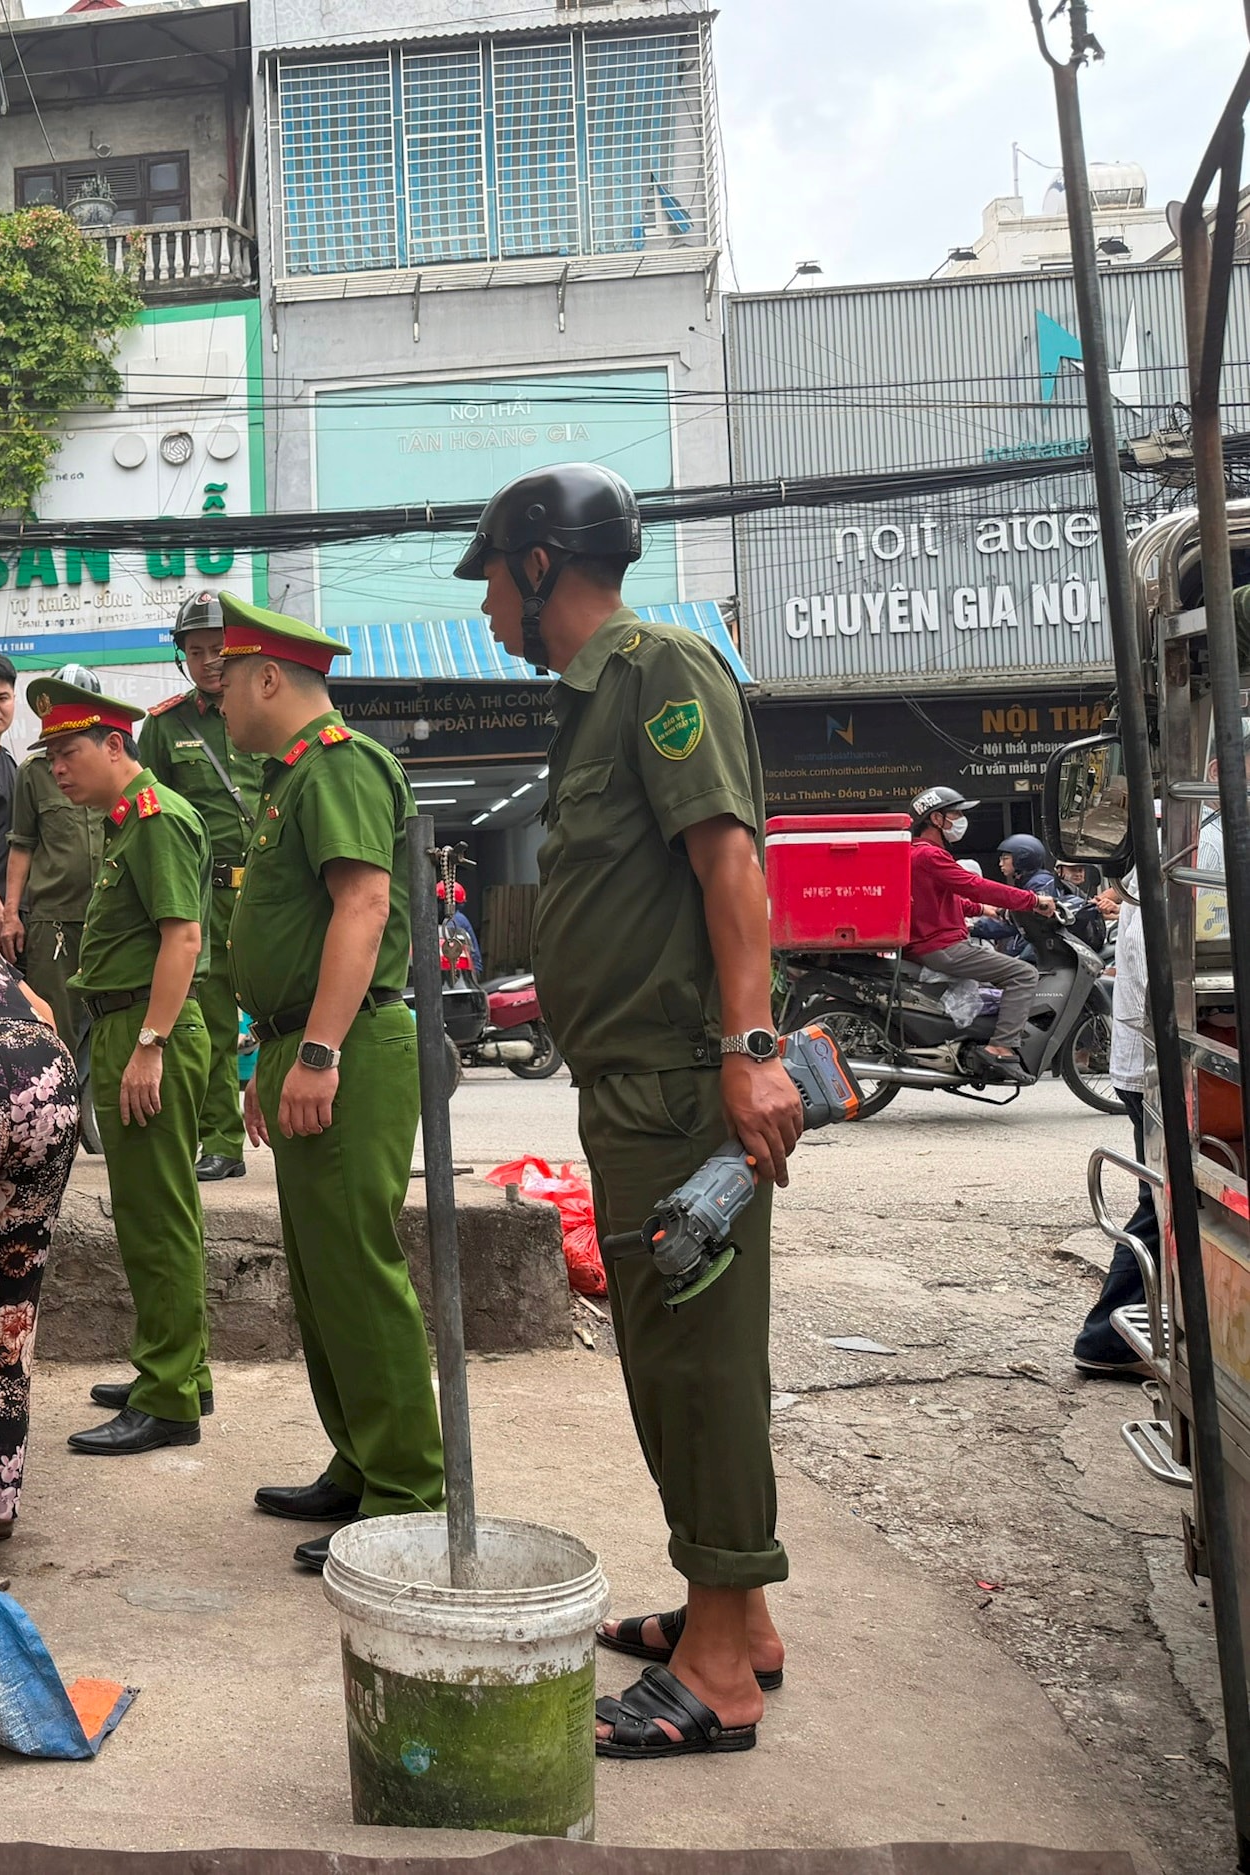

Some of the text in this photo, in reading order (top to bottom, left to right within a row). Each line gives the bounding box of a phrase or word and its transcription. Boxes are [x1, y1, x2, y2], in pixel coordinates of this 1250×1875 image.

[398, 423, 590, 455] TÂN HOÀNG GIA
[38, 593, 80, 613] NHIÊN
[93, 590, 132, 608] CÔNG
[785, 572, 1102, 640] CHUYÊN GIA NỘI
[358, 697, 390, 717] VẤN
[394, 693, 430, 714] THIẾT
[434, 692, 454, 712] KẾ
[456, 693, 476, 711] VÀ
[480, 695, 501, 709] THI
[480, 711, 527, 729] HÀNG
[981, 704, 1038, 737] NỘI
[983, 742, 1003, 758] Nội
[1005, 740, 1028, 755] thất
[970, 763, 984, 775] Tư
[986, 760, 1006, 775] vấn
[1009, 760, 1037, 775] miễn
[784, 788, 798, 800] La
[869, 787, 883, 797] Đa
[893, 786, 907, 796] Hà
